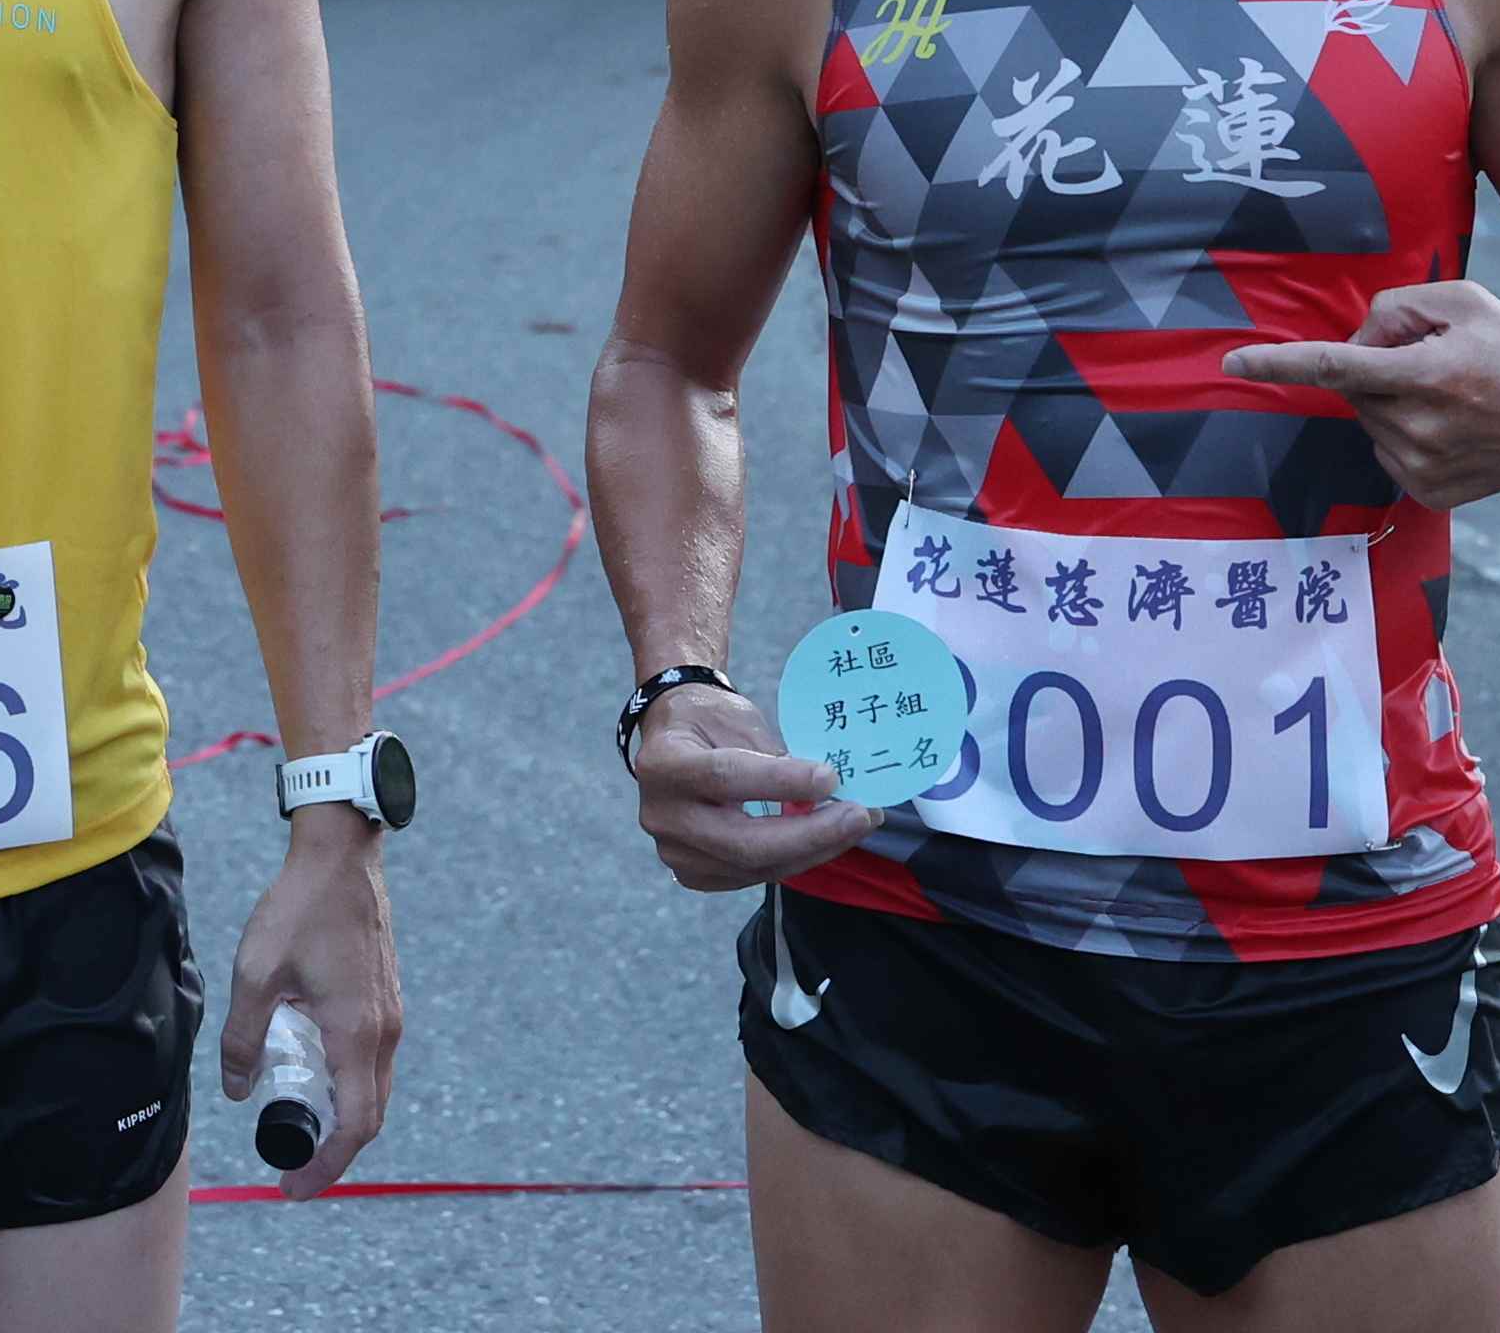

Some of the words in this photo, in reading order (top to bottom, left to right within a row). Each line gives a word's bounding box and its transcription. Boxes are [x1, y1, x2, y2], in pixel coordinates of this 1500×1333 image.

[977, 57, 1327, 201] 花蓮
[906, 535, 1350, 631] 花蓮慈濟醫院
[828, 641, 899, 678] 社區
[824, 690, 929, 732] 男子組
[824, 736, 939, 786] 第二名
[117, 1100, 161, 1132] KIPRUN
